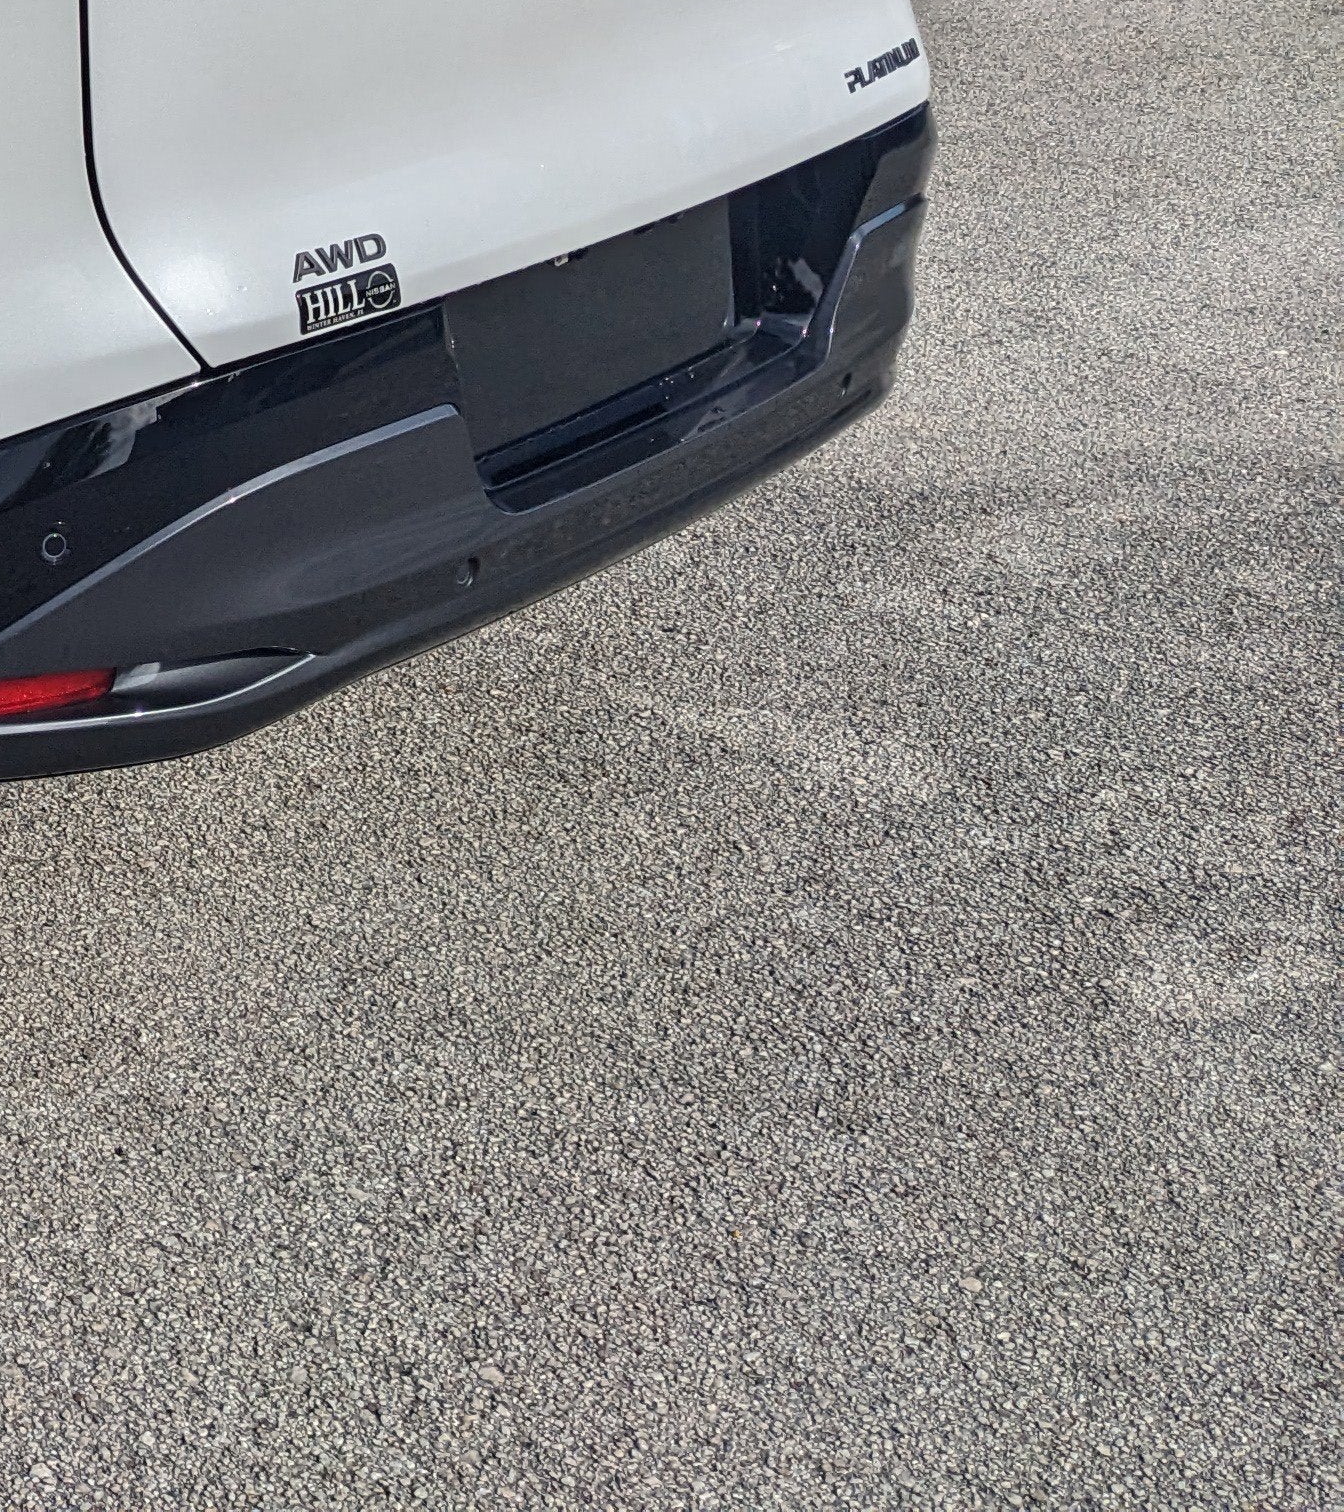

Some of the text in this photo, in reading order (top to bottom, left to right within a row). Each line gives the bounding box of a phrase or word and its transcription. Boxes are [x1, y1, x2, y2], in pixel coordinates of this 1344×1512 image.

[844, 37, 920, 94] PLATINUM
[292, 233, 387, 283] AWD
[301, 279, 366, 325] HILL
[365, 282, 396, 298] NISSAN
